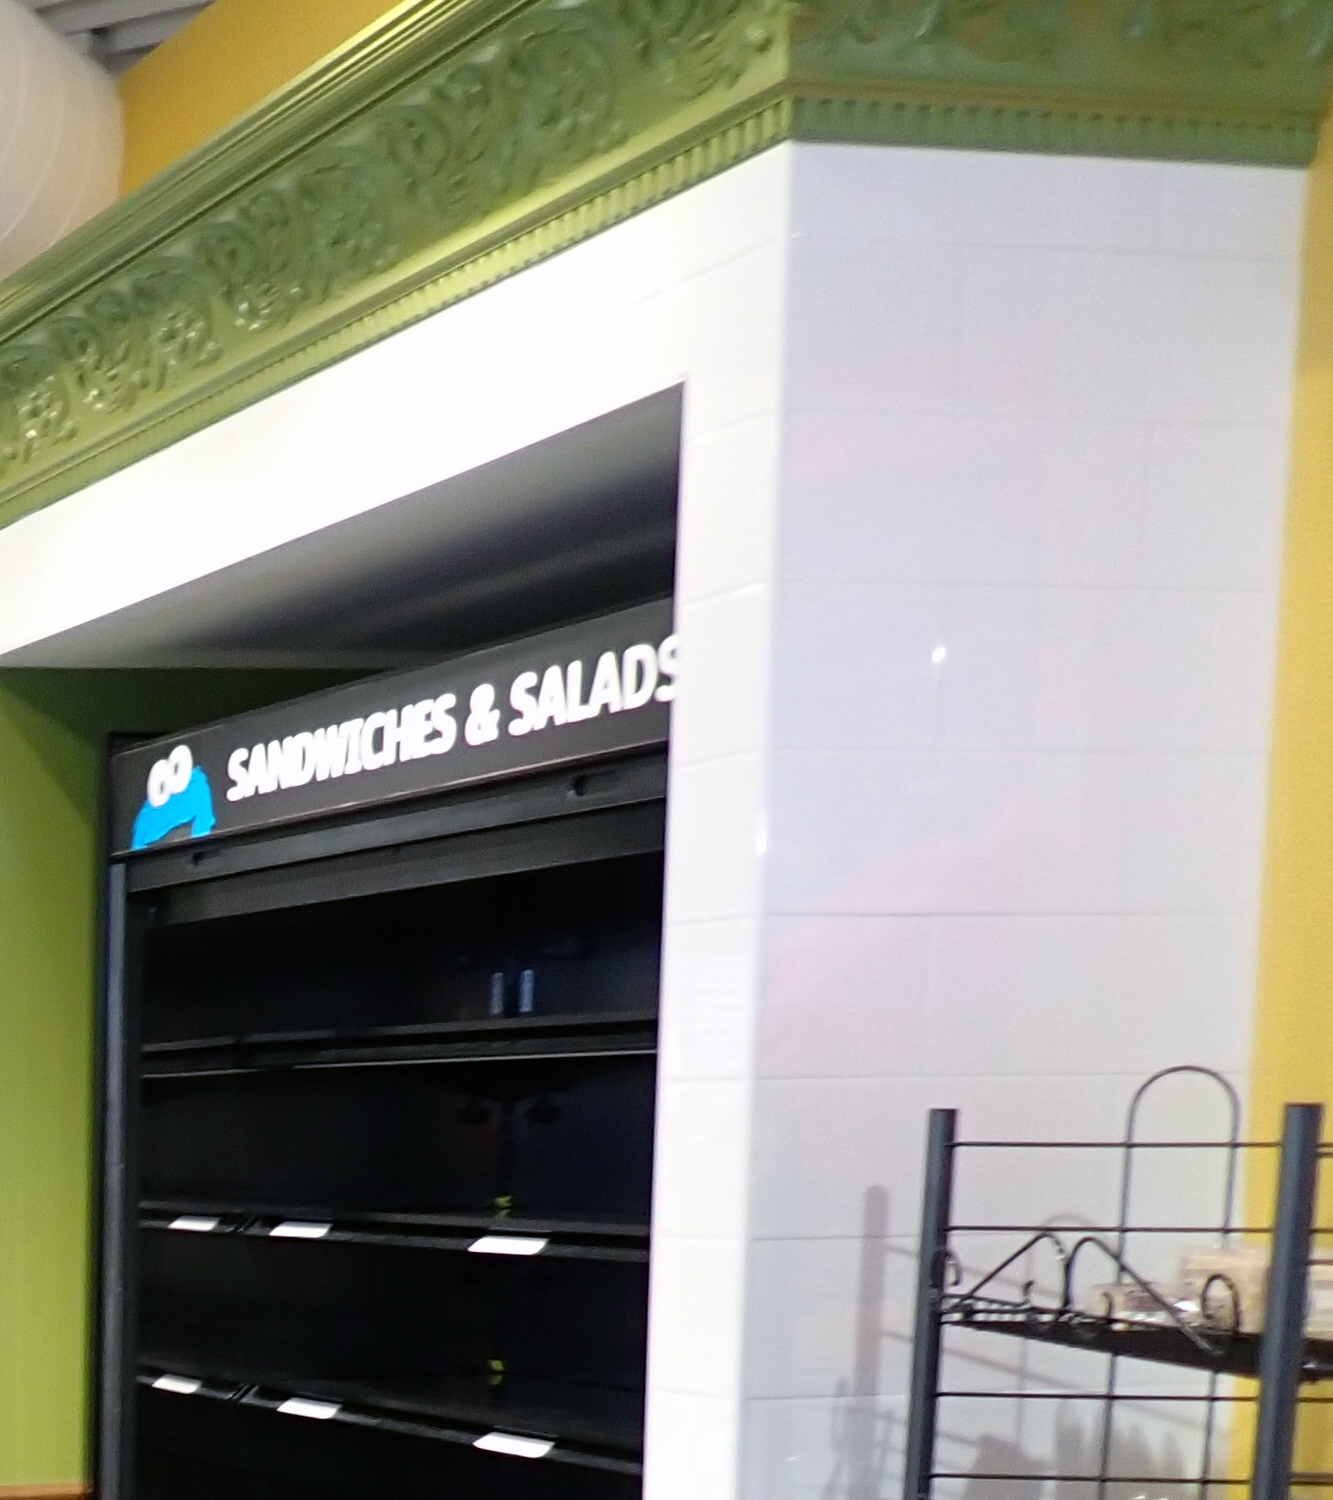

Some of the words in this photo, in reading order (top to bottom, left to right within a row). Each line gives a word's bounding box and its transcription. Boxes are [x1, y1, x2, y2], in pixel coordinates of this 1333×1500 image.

[226, 693, 457, 802] SANDWICHES
[464, 683, 501, 747] &
[507, 636, 678, 736] SALADS
